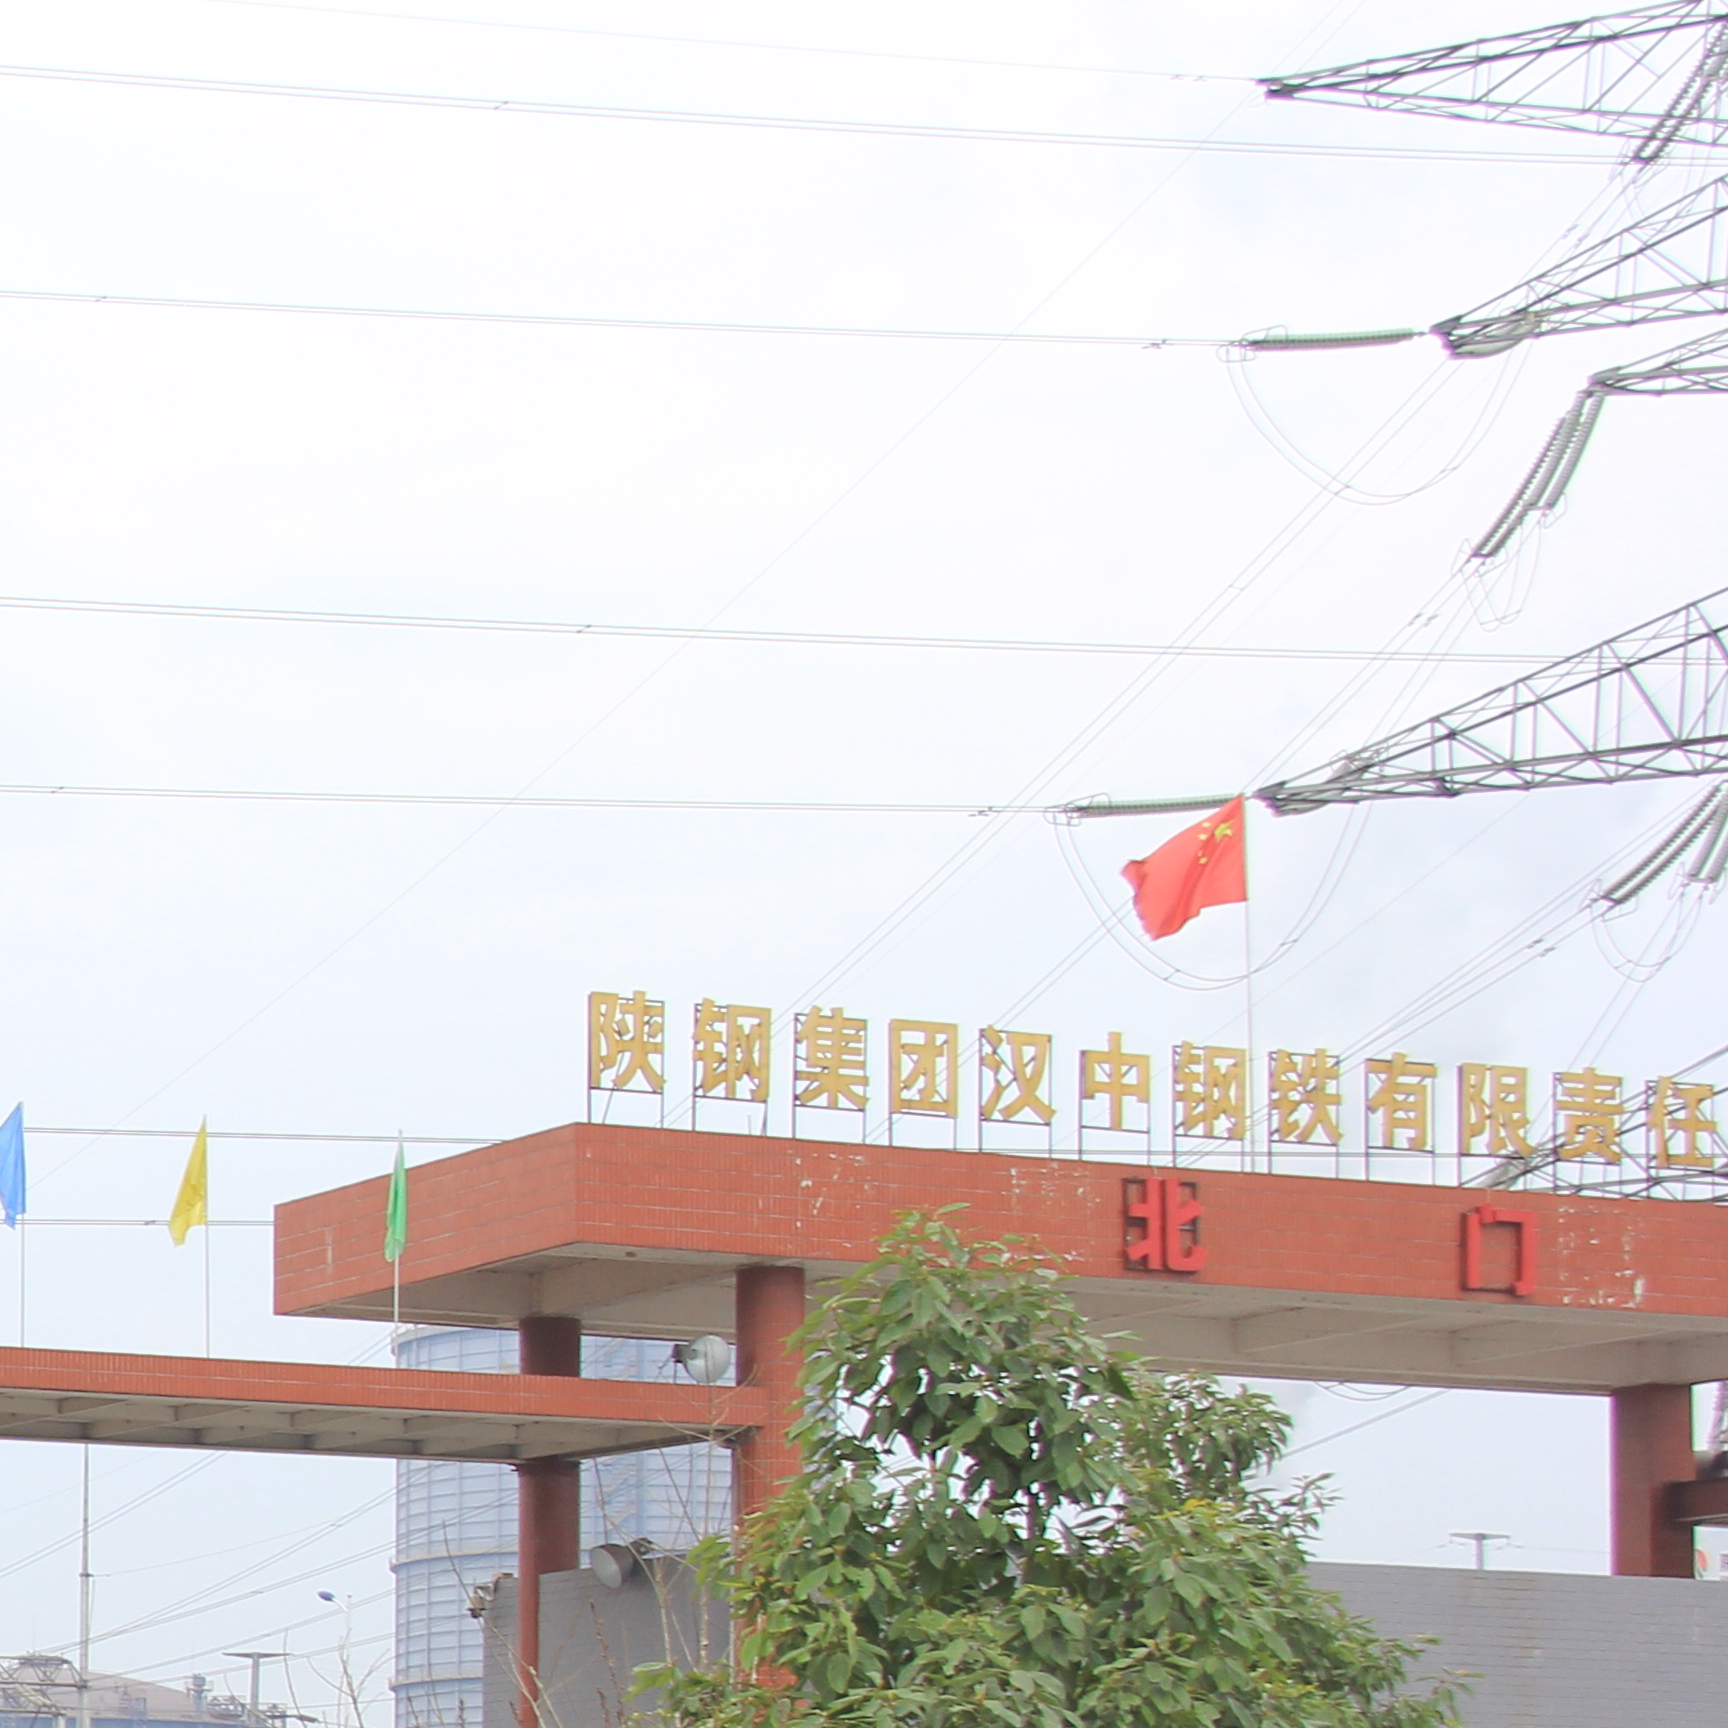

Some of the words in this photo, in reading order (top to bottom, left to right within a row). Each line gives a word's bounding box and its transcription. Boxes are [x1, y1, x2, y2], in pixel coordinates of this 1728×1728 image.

[588, 990, 1717, 1170] 陕钢集团汉中钢铁有限责任
[1125, 1177, 1537, 1297] 北门
